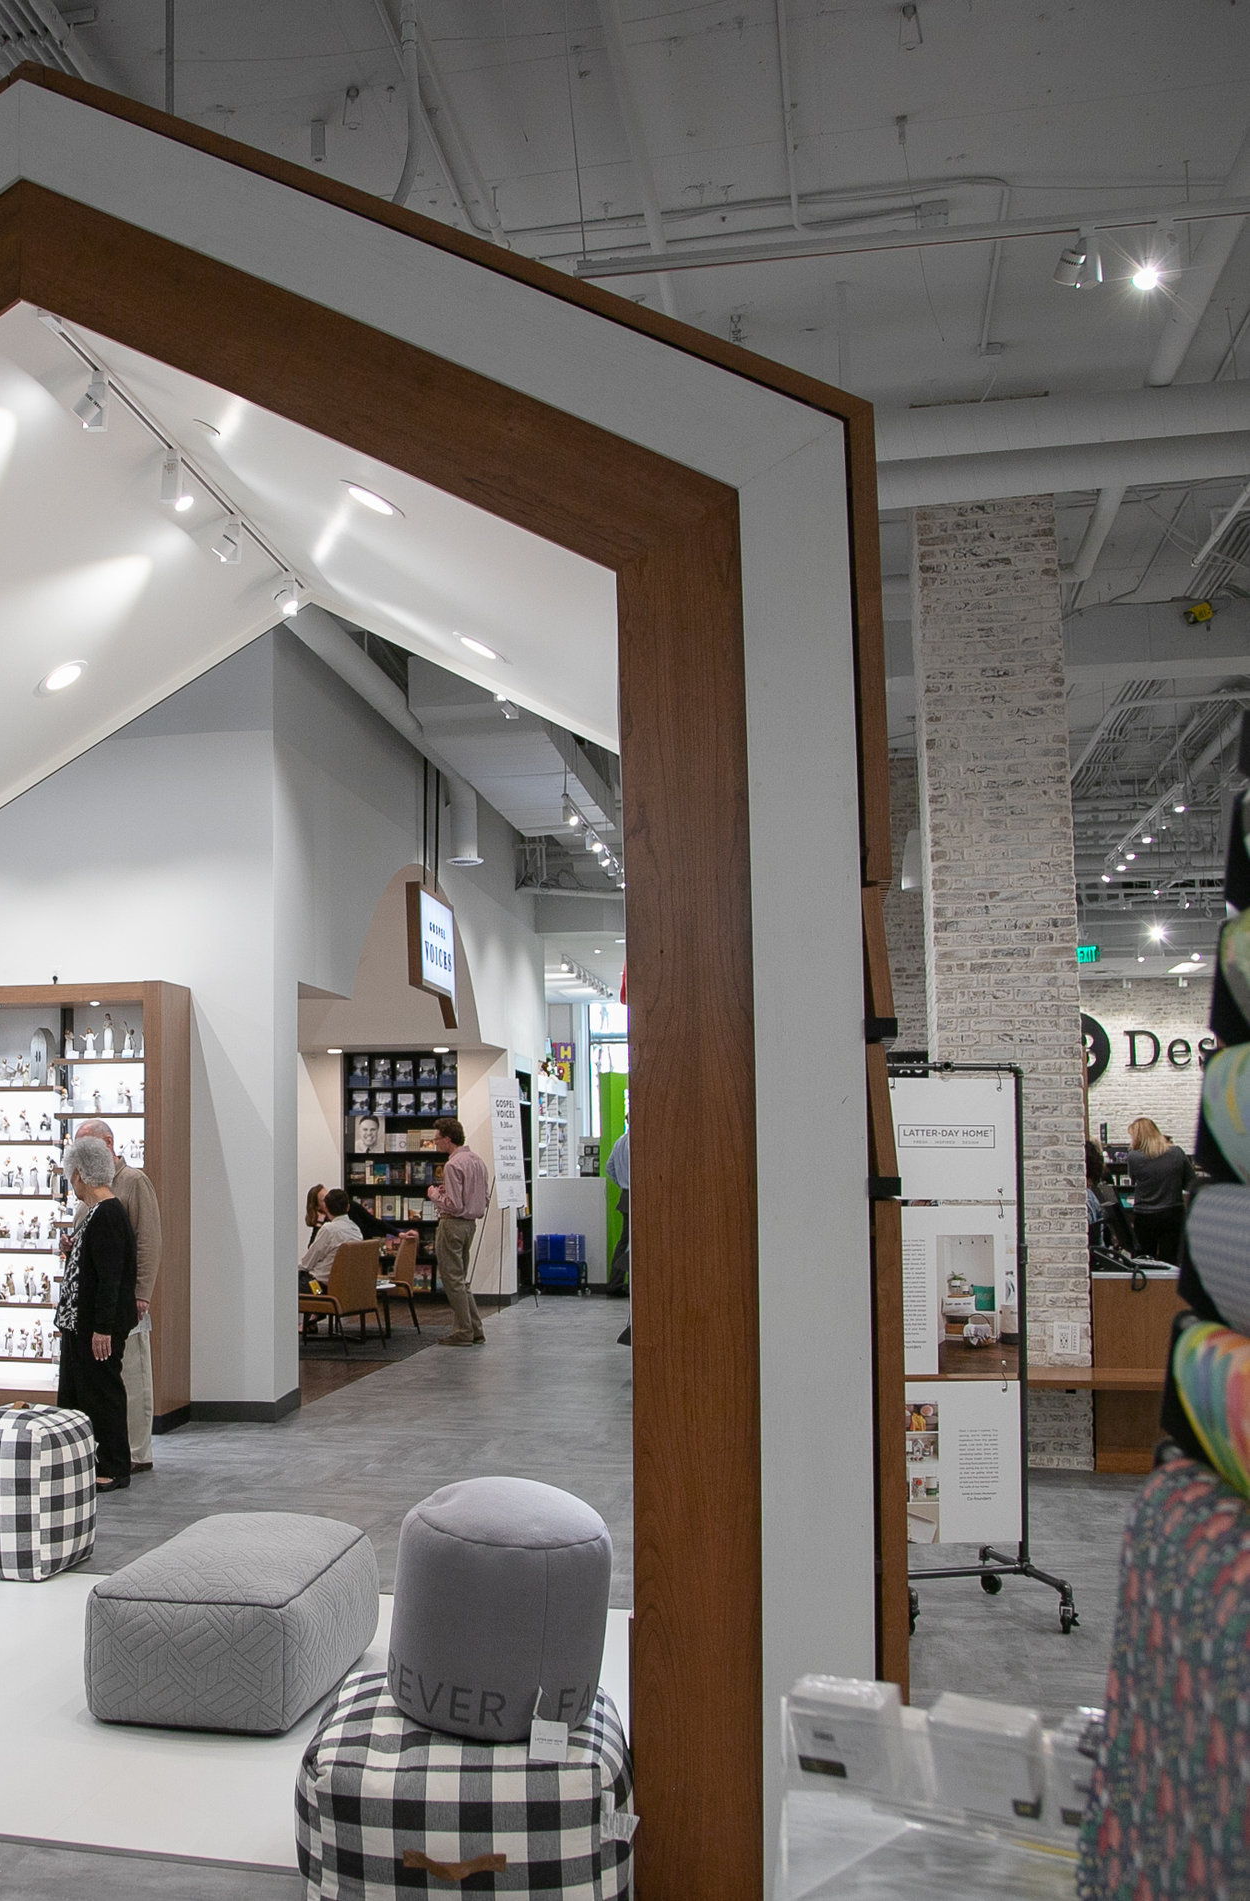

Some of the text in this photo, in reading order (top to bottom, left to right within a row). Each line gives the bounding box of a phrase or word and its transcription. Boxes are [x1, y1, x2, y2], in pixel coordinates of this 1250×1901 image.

[429, 921, 446, 940] GOSPEL
[424, 940, 452, 972] VOICES
[1077, 947, 1097, 962] EXIT
[560, 1046, 572, 1059] H
[495, 1099, 515, 1109] GOSPEL
[496, 1109, 516, 1118] VOICES
